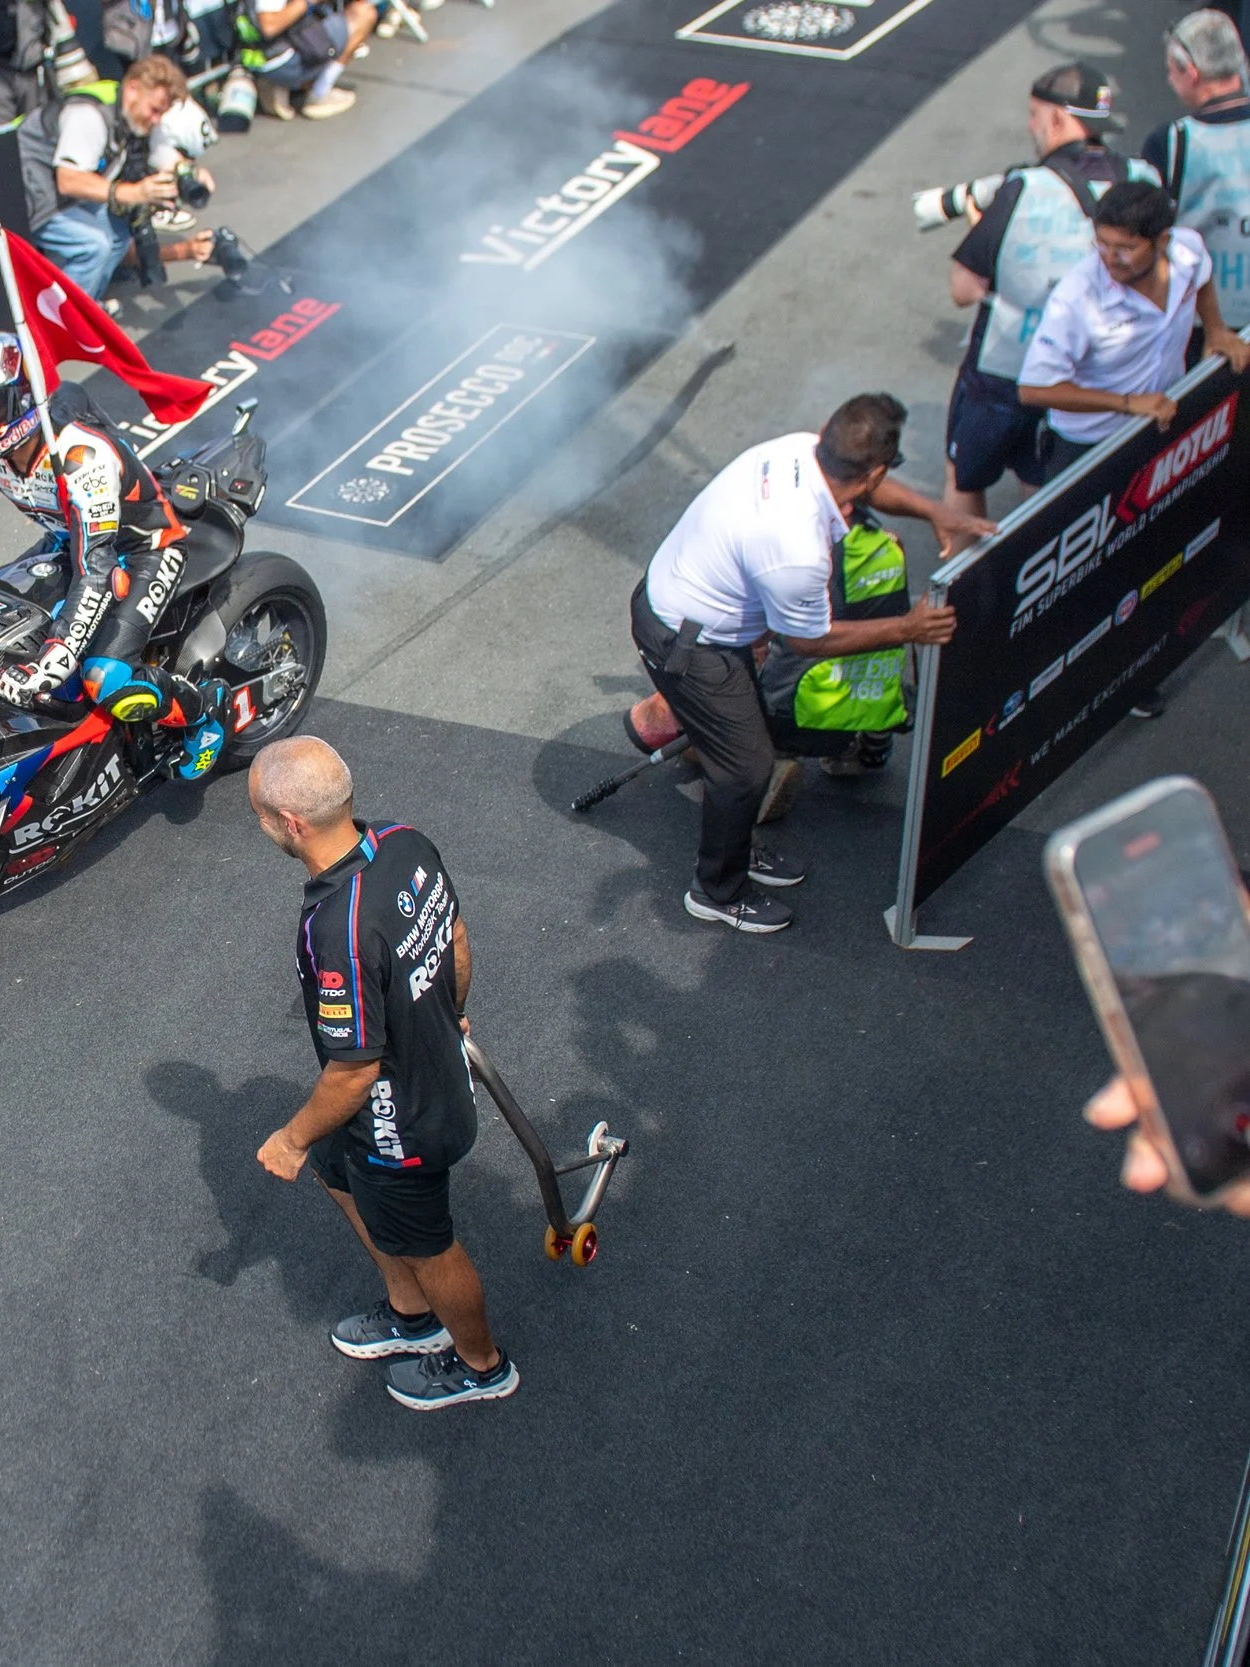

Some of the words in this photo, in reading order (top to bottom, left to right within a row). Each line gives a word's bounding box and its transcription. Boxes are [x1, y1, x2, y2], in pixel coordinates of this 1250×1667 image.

[459, 139, 661, 271] Victory
[365, 363, 524, 476] PROSECCO
[35, 472, 55, 484] ROK
[1147, 403, 1230, 500] MOTUL
[82, 474, 108, 493] ebc
[1009, 607, 1033, 640] FIM
[1037, 553, 1103, 619] SUPERBIKE
[1105, 513, 1146, 557] WORLD
[1149, 442, 1230, 520] CHAMPIONSHIP
[234, 686, 256, 733] 1
[1030, 745, 1050, 765] WE
[1054, 703, 1088, 745] MAKE
[396, 924, 420, 959] BMW
[408, 911, 437, 960] WorldSBK
